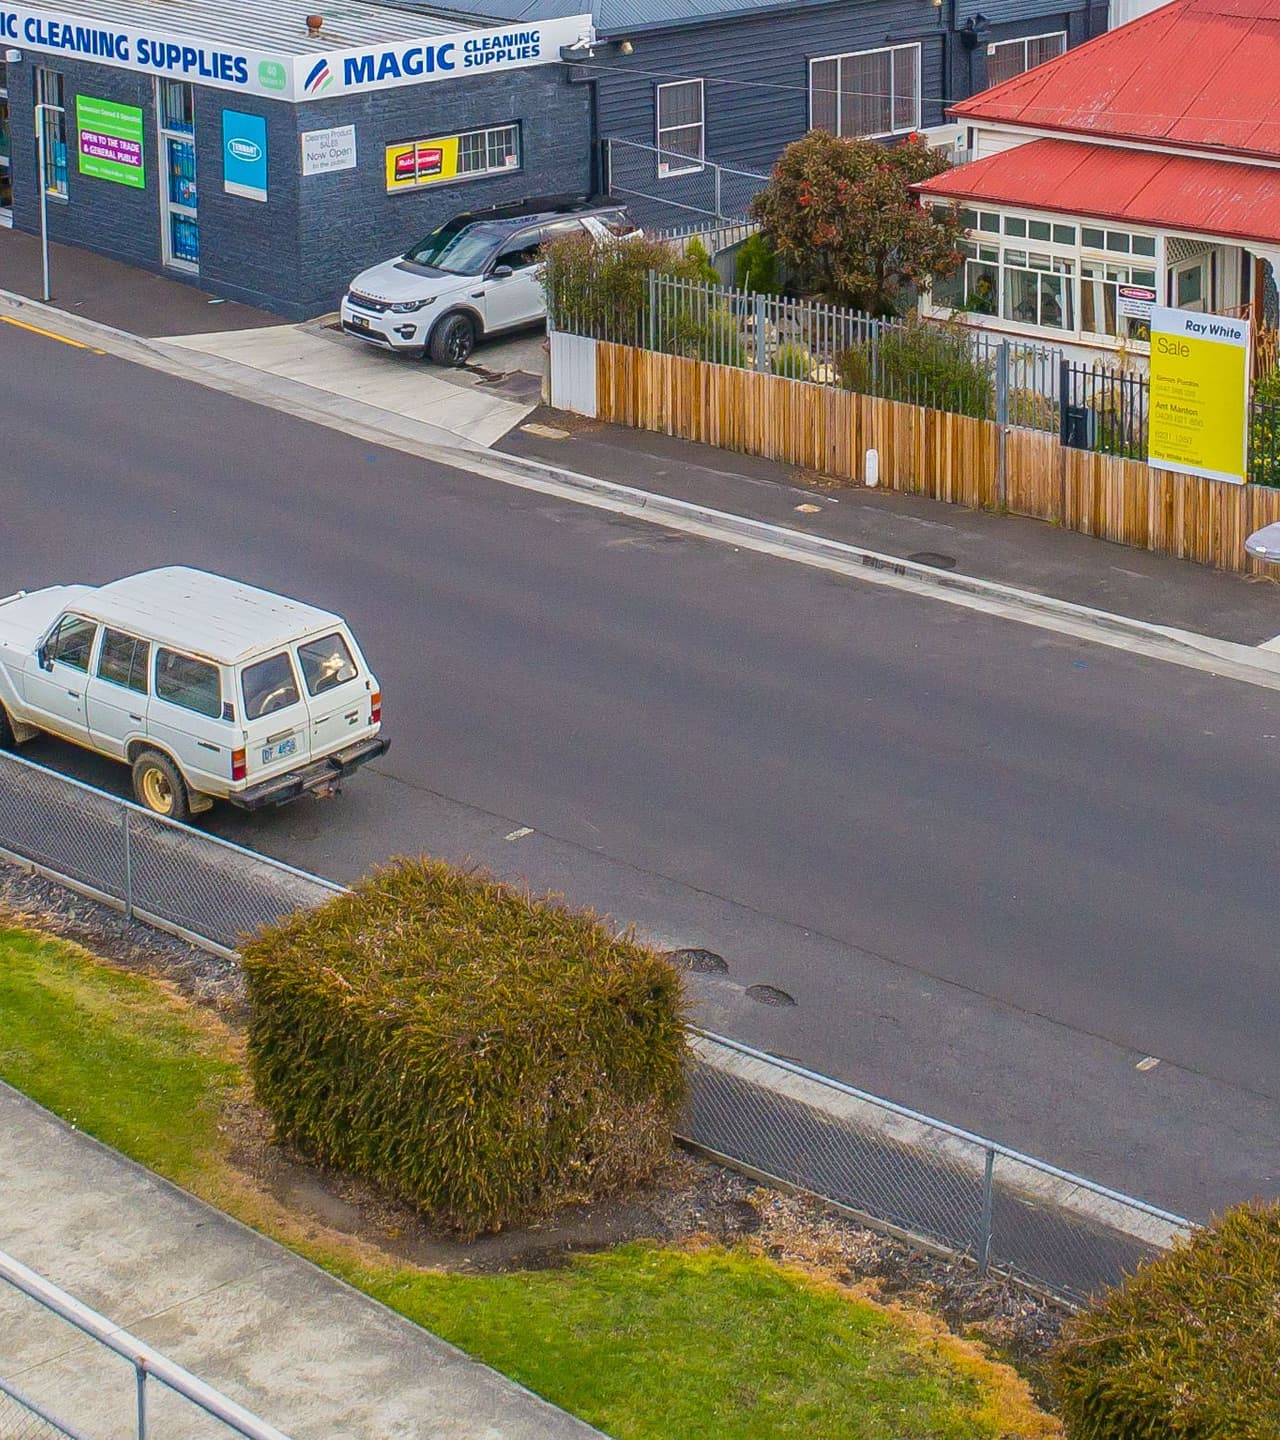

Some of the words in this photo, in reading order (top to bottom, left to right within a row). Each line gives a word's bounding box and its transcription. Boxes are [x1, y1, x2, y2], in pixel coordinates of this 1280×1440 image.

[24, 17, 129, 61] CLEANING
[137, 38, 248, 84] SUPPLIES
[344, 43, 456, 86] MAGIC
[463, 30, 541, 54] CLEANING
[463, 44, 541, 68] SUPPLIES
[81, 131, 98, 144] OPEN
[99, 135, 107, 145] TO
[108, 137, 119, 148] THE
[120, 140, 140, 153] TRADE
[89, 145, 117, 160] GENERAL
[117, 152, 140, 165] PUBLIC
[306, 151, 327, 161] Now
[329, 148, 353, 158] Open
[1185, 319, 1207, 336] Ray
[1209, 323, 1242, 340] White
[1157, 336, 1190, 358] Sale
